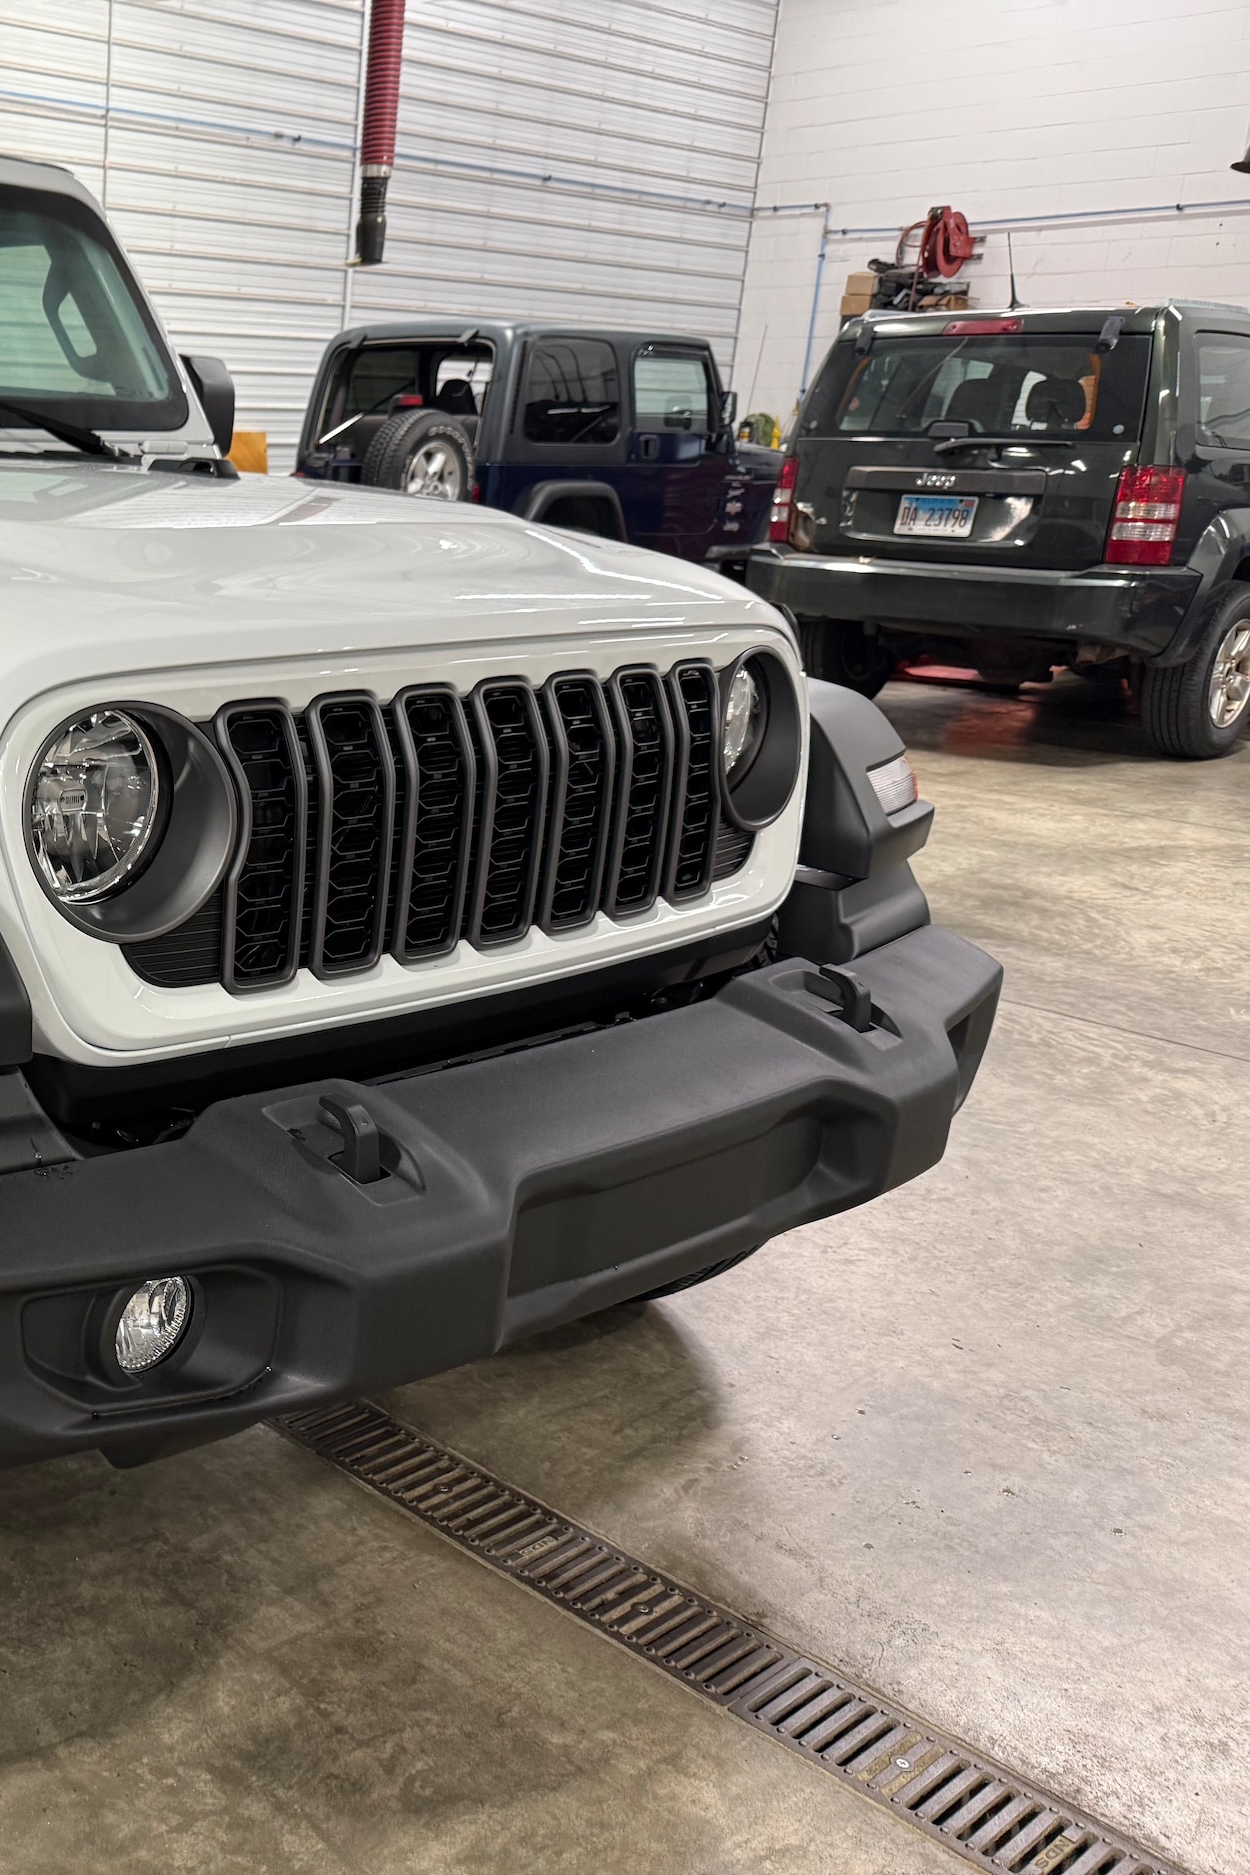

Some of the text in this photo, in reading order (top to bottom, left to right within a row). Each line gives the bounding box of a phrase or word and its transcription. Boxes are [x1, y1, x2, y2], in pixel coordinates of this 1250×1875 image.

[916, 472, 956, 489] Jeep
[900, 507, 969, 528] DA 23798
[1035, 1839, 1069, 1869] NDS
